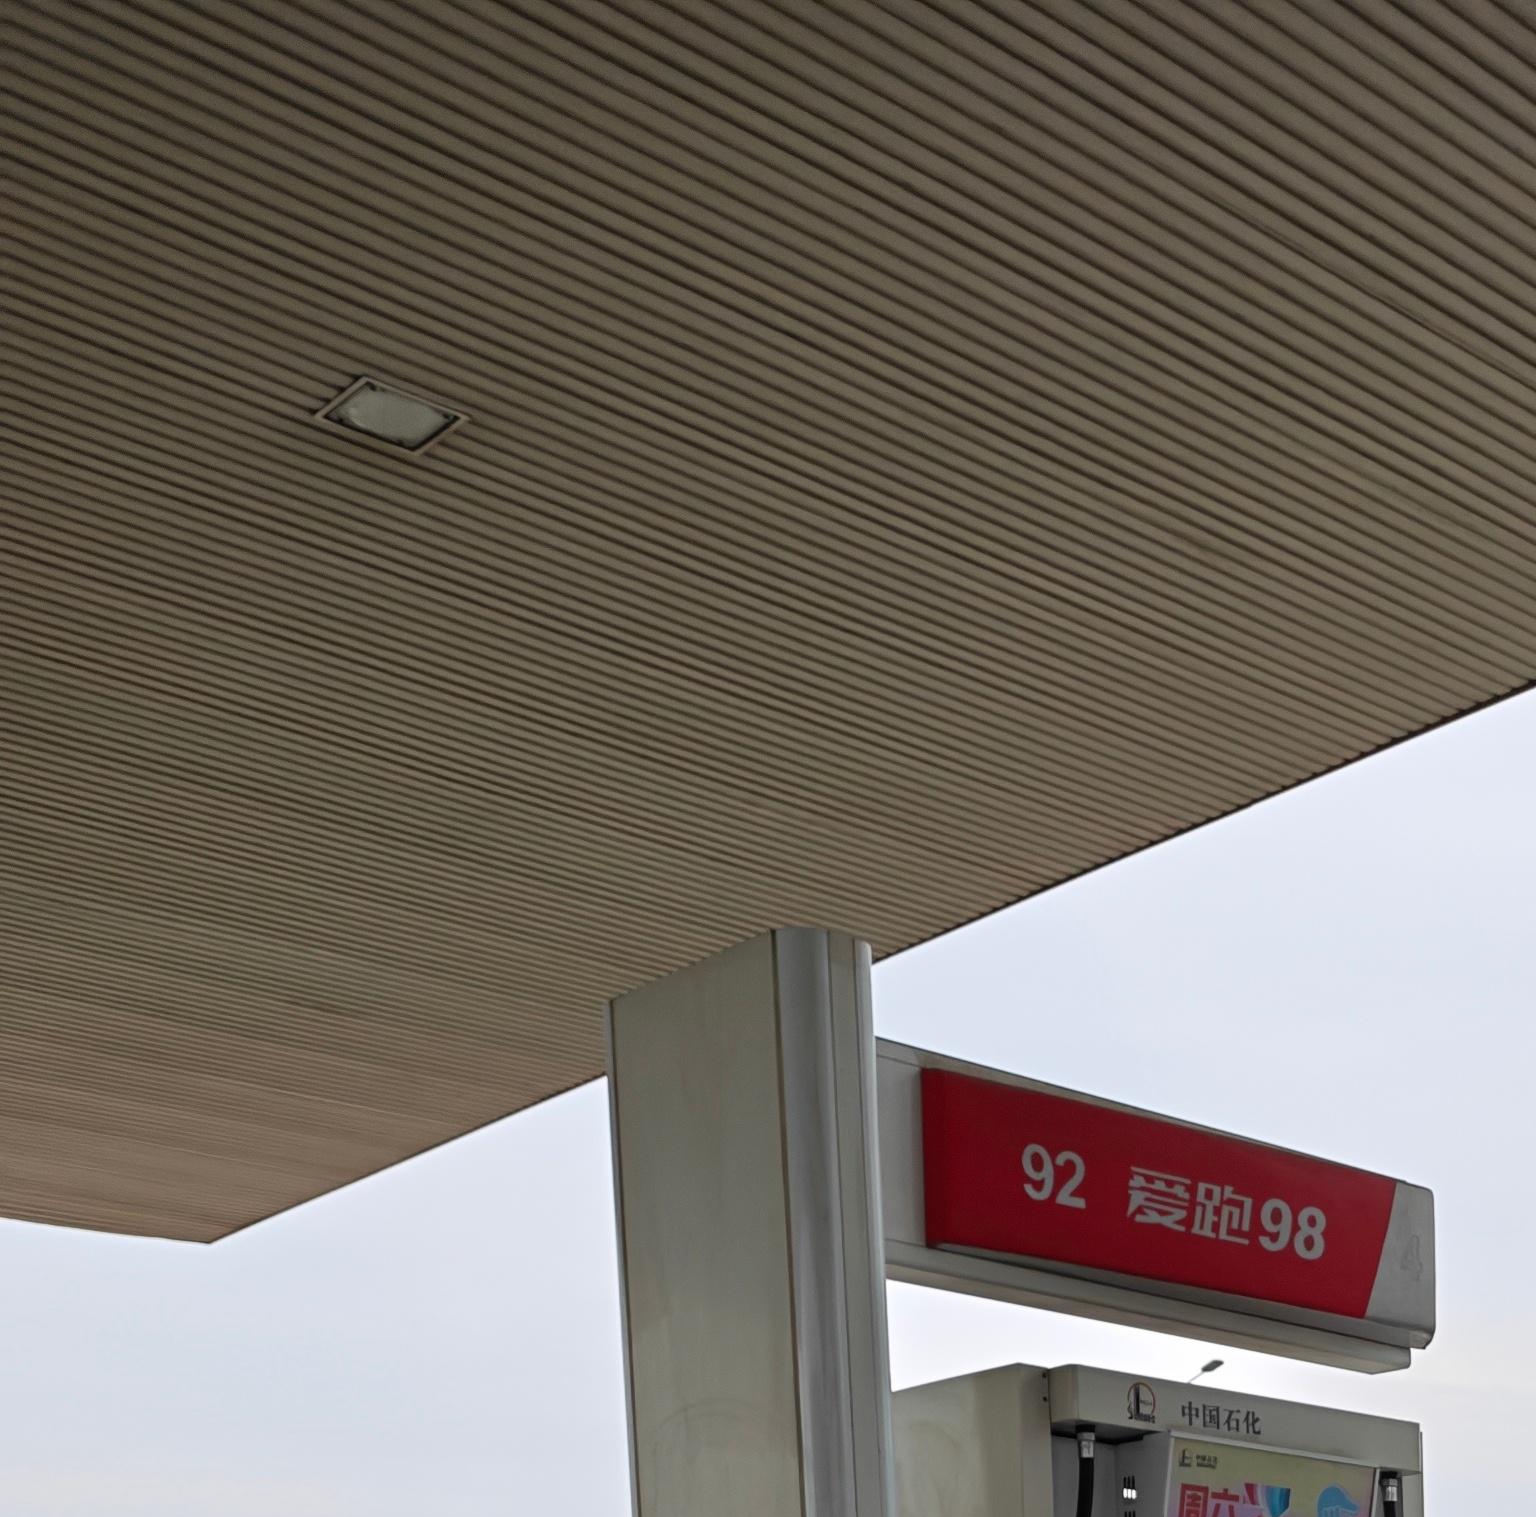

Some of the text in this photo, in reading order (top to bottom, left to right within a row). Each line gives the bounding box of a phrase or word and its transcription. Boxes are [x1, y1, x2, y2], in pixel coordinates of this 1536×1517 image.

[1020, 1143, 1328, 1261] 92 爱跑98
[1181, 1400, 1262, 1436] 中国石化
